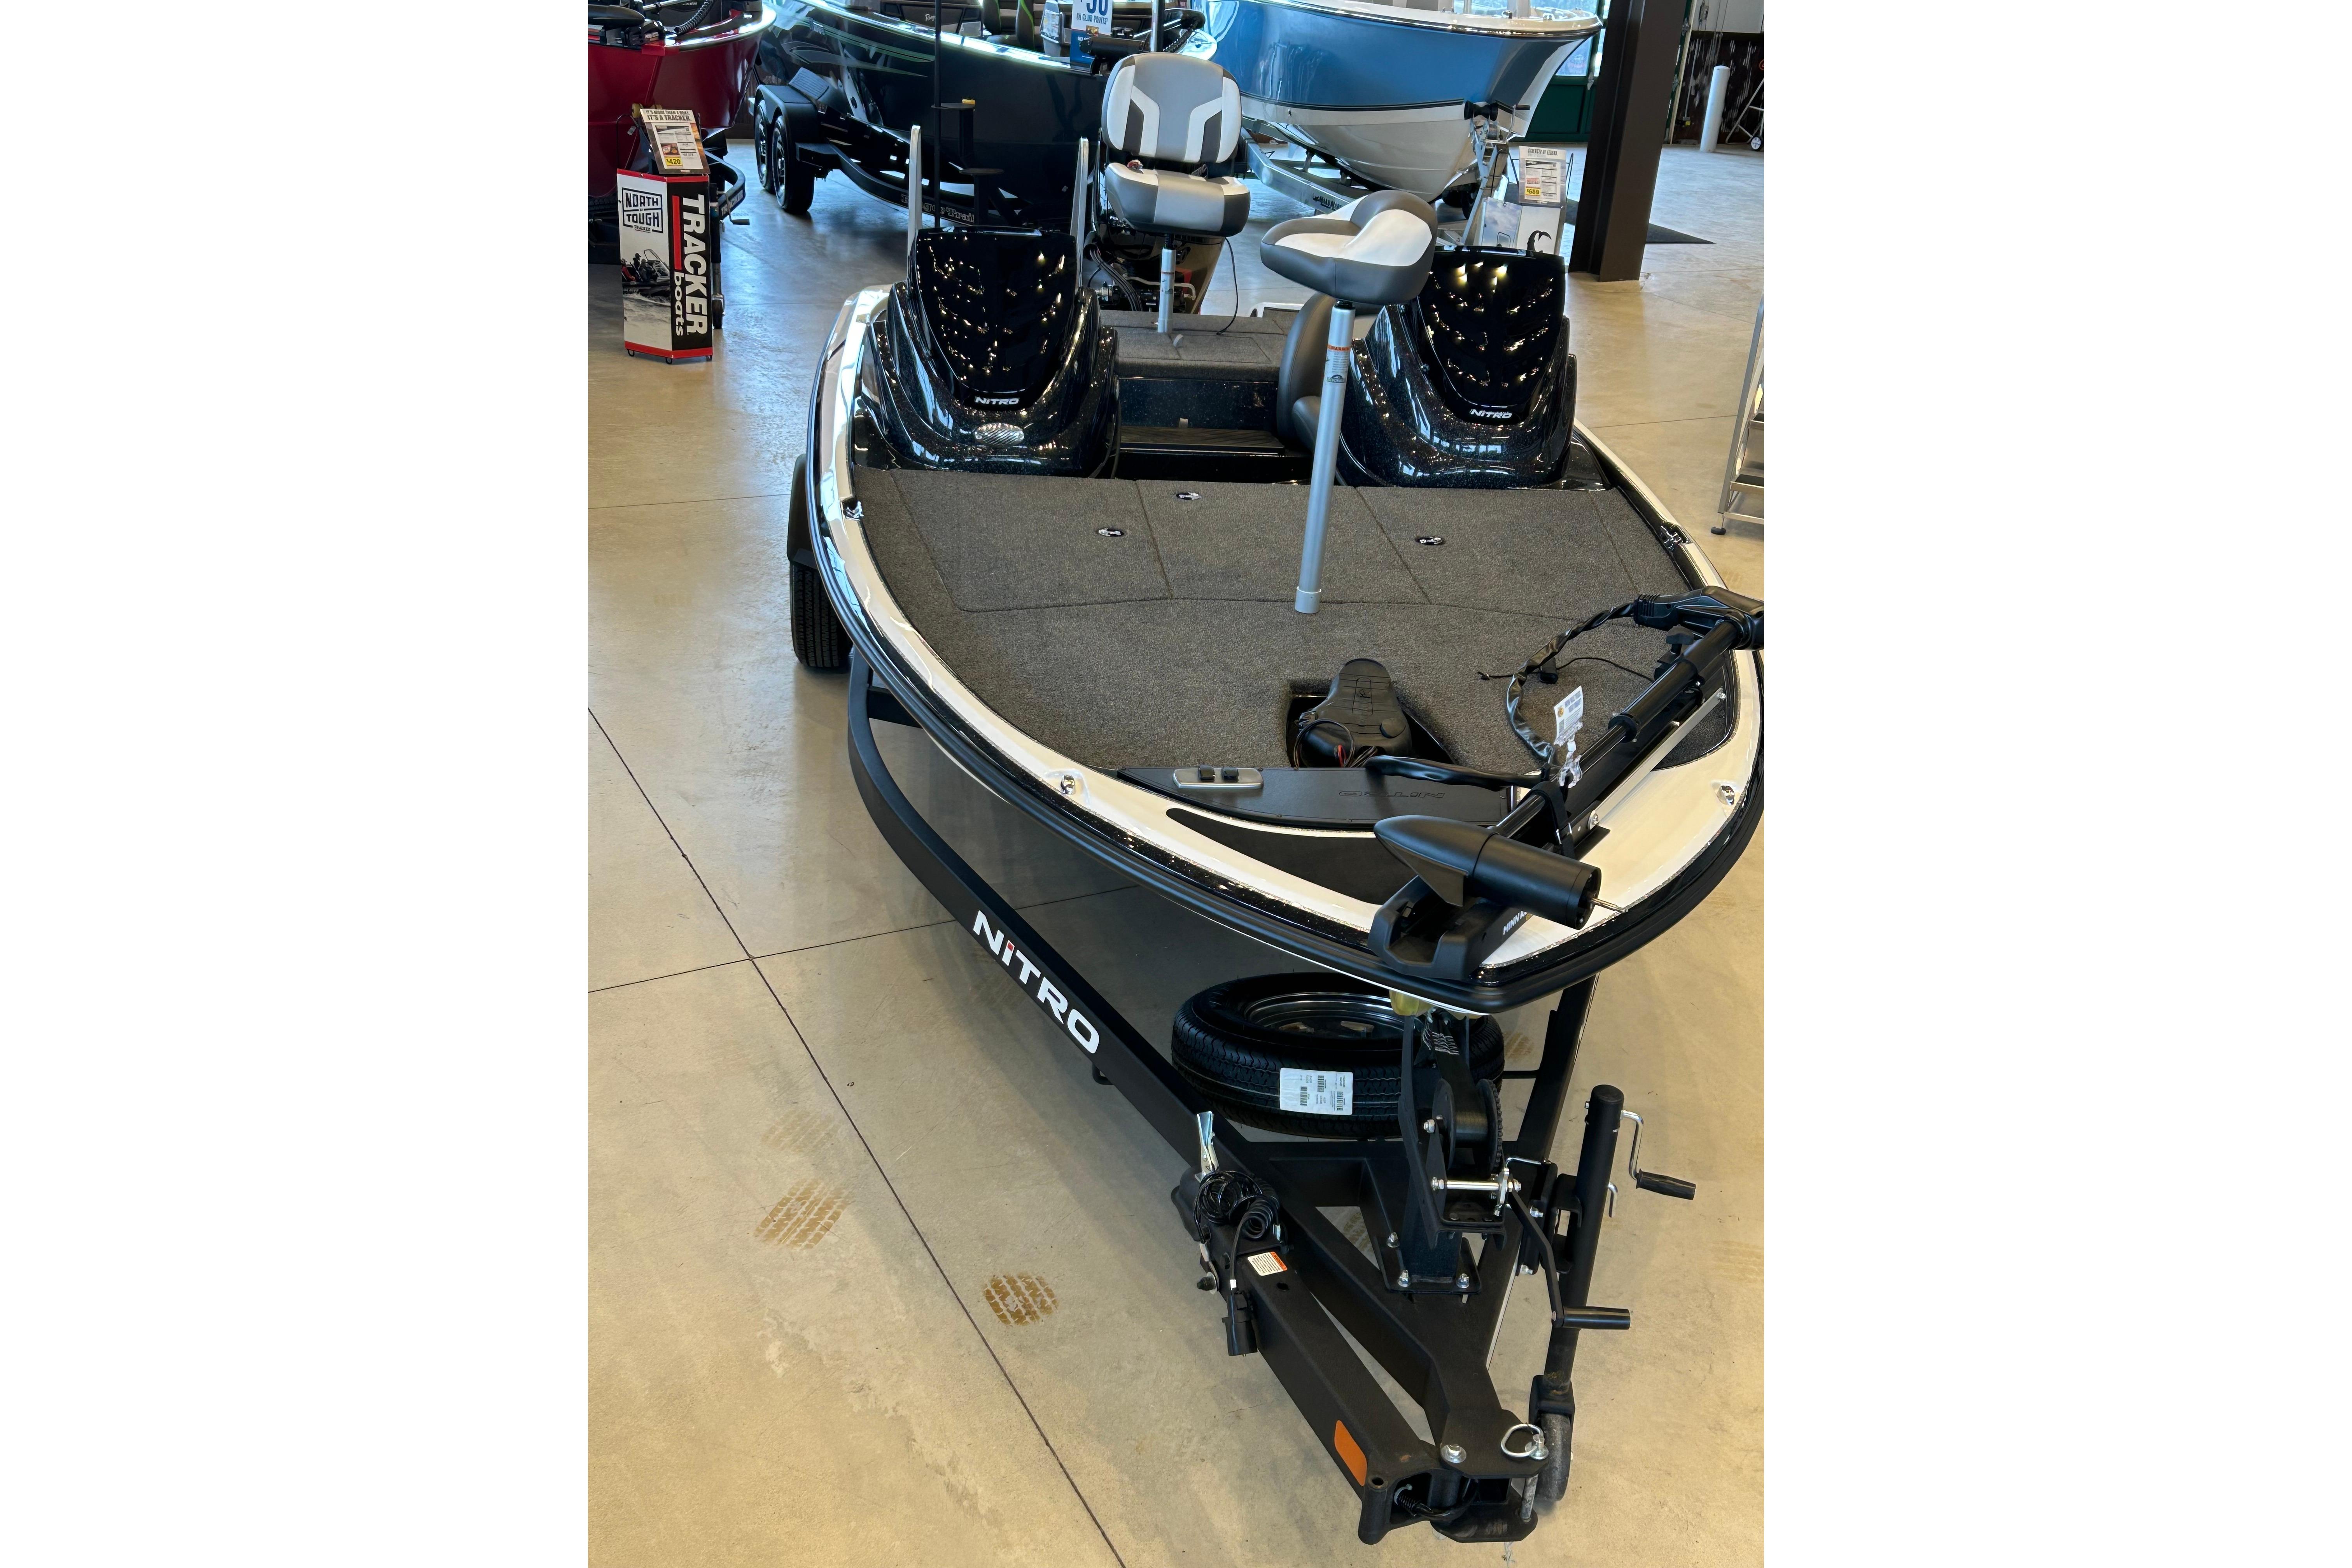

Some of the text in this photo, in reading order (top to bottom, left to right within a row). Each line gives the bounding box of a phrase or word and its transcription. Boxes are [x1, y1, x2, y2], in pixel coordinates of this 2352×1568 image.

[625, 192, 658, 208] NORTH
[626, 212, 659, 228] TOUGH
[682, 194, 708, 336] TRACKER
[674, 271, 684, 336] boats
